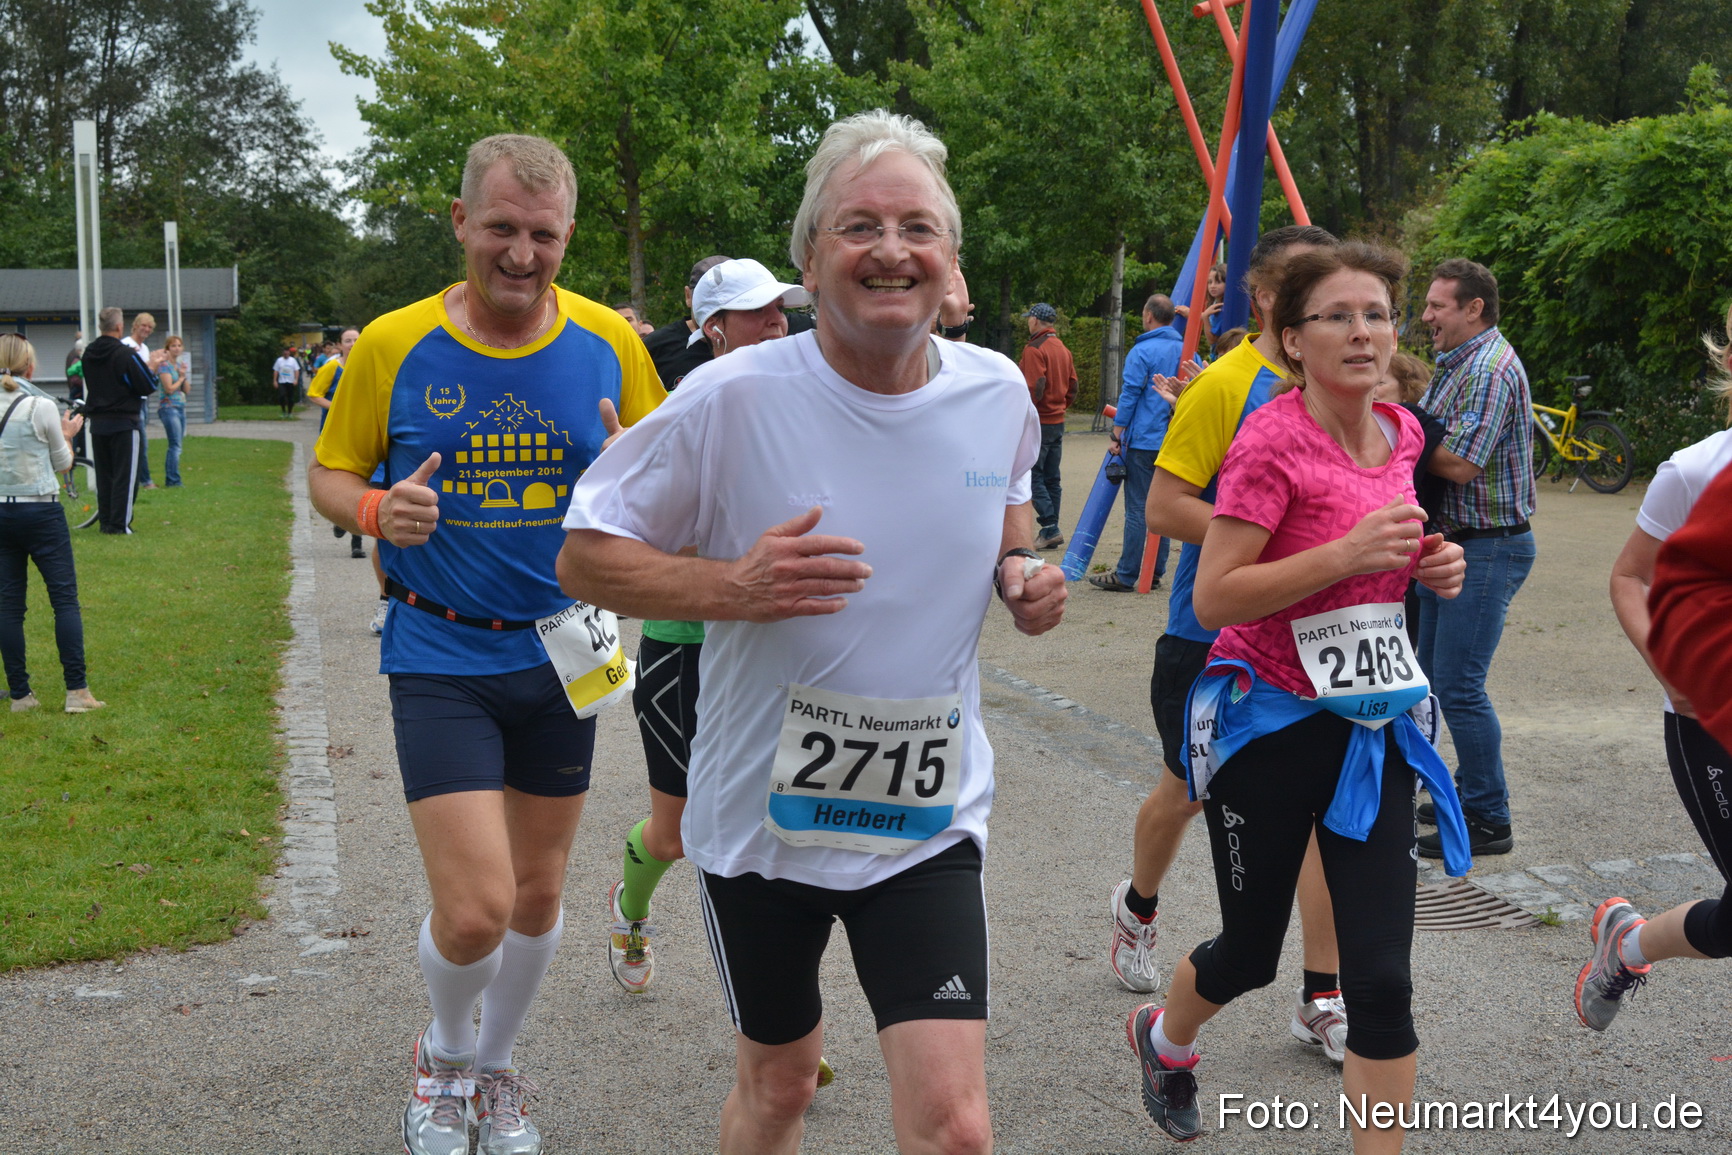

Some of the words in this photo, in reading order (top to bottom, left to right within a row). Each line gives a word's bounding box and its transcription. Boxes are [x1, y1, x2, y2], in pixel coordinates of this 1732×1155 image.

[440, 387, 450, 395] 15
[458, 468, 534, 479] 21.September
[537, 467, 563, 476] 2014
[965, 471, 1008, 488] Herbert
[539, 608, 575, 636] PARTL
[1298, 623, 1348, 645] PARTL
[1350, 616, 1393, 632] Neumarkt
[1318, 635, 1414, 689] 2463
[790, 699, 853, 729] PARTL
[858, 715, 942, 732] Neumarkt
[1357, 699, 1389, 717] Lisa
[791, 731, 949, 799] 2715
[776, 782, 784, 793] B
[1712, 781, 1730, 819] odlo
[813, 803, 907, 831] Herbert
[1227, 831, 1246, 892] odlo
[933, 990, 971, 1000] adidas
